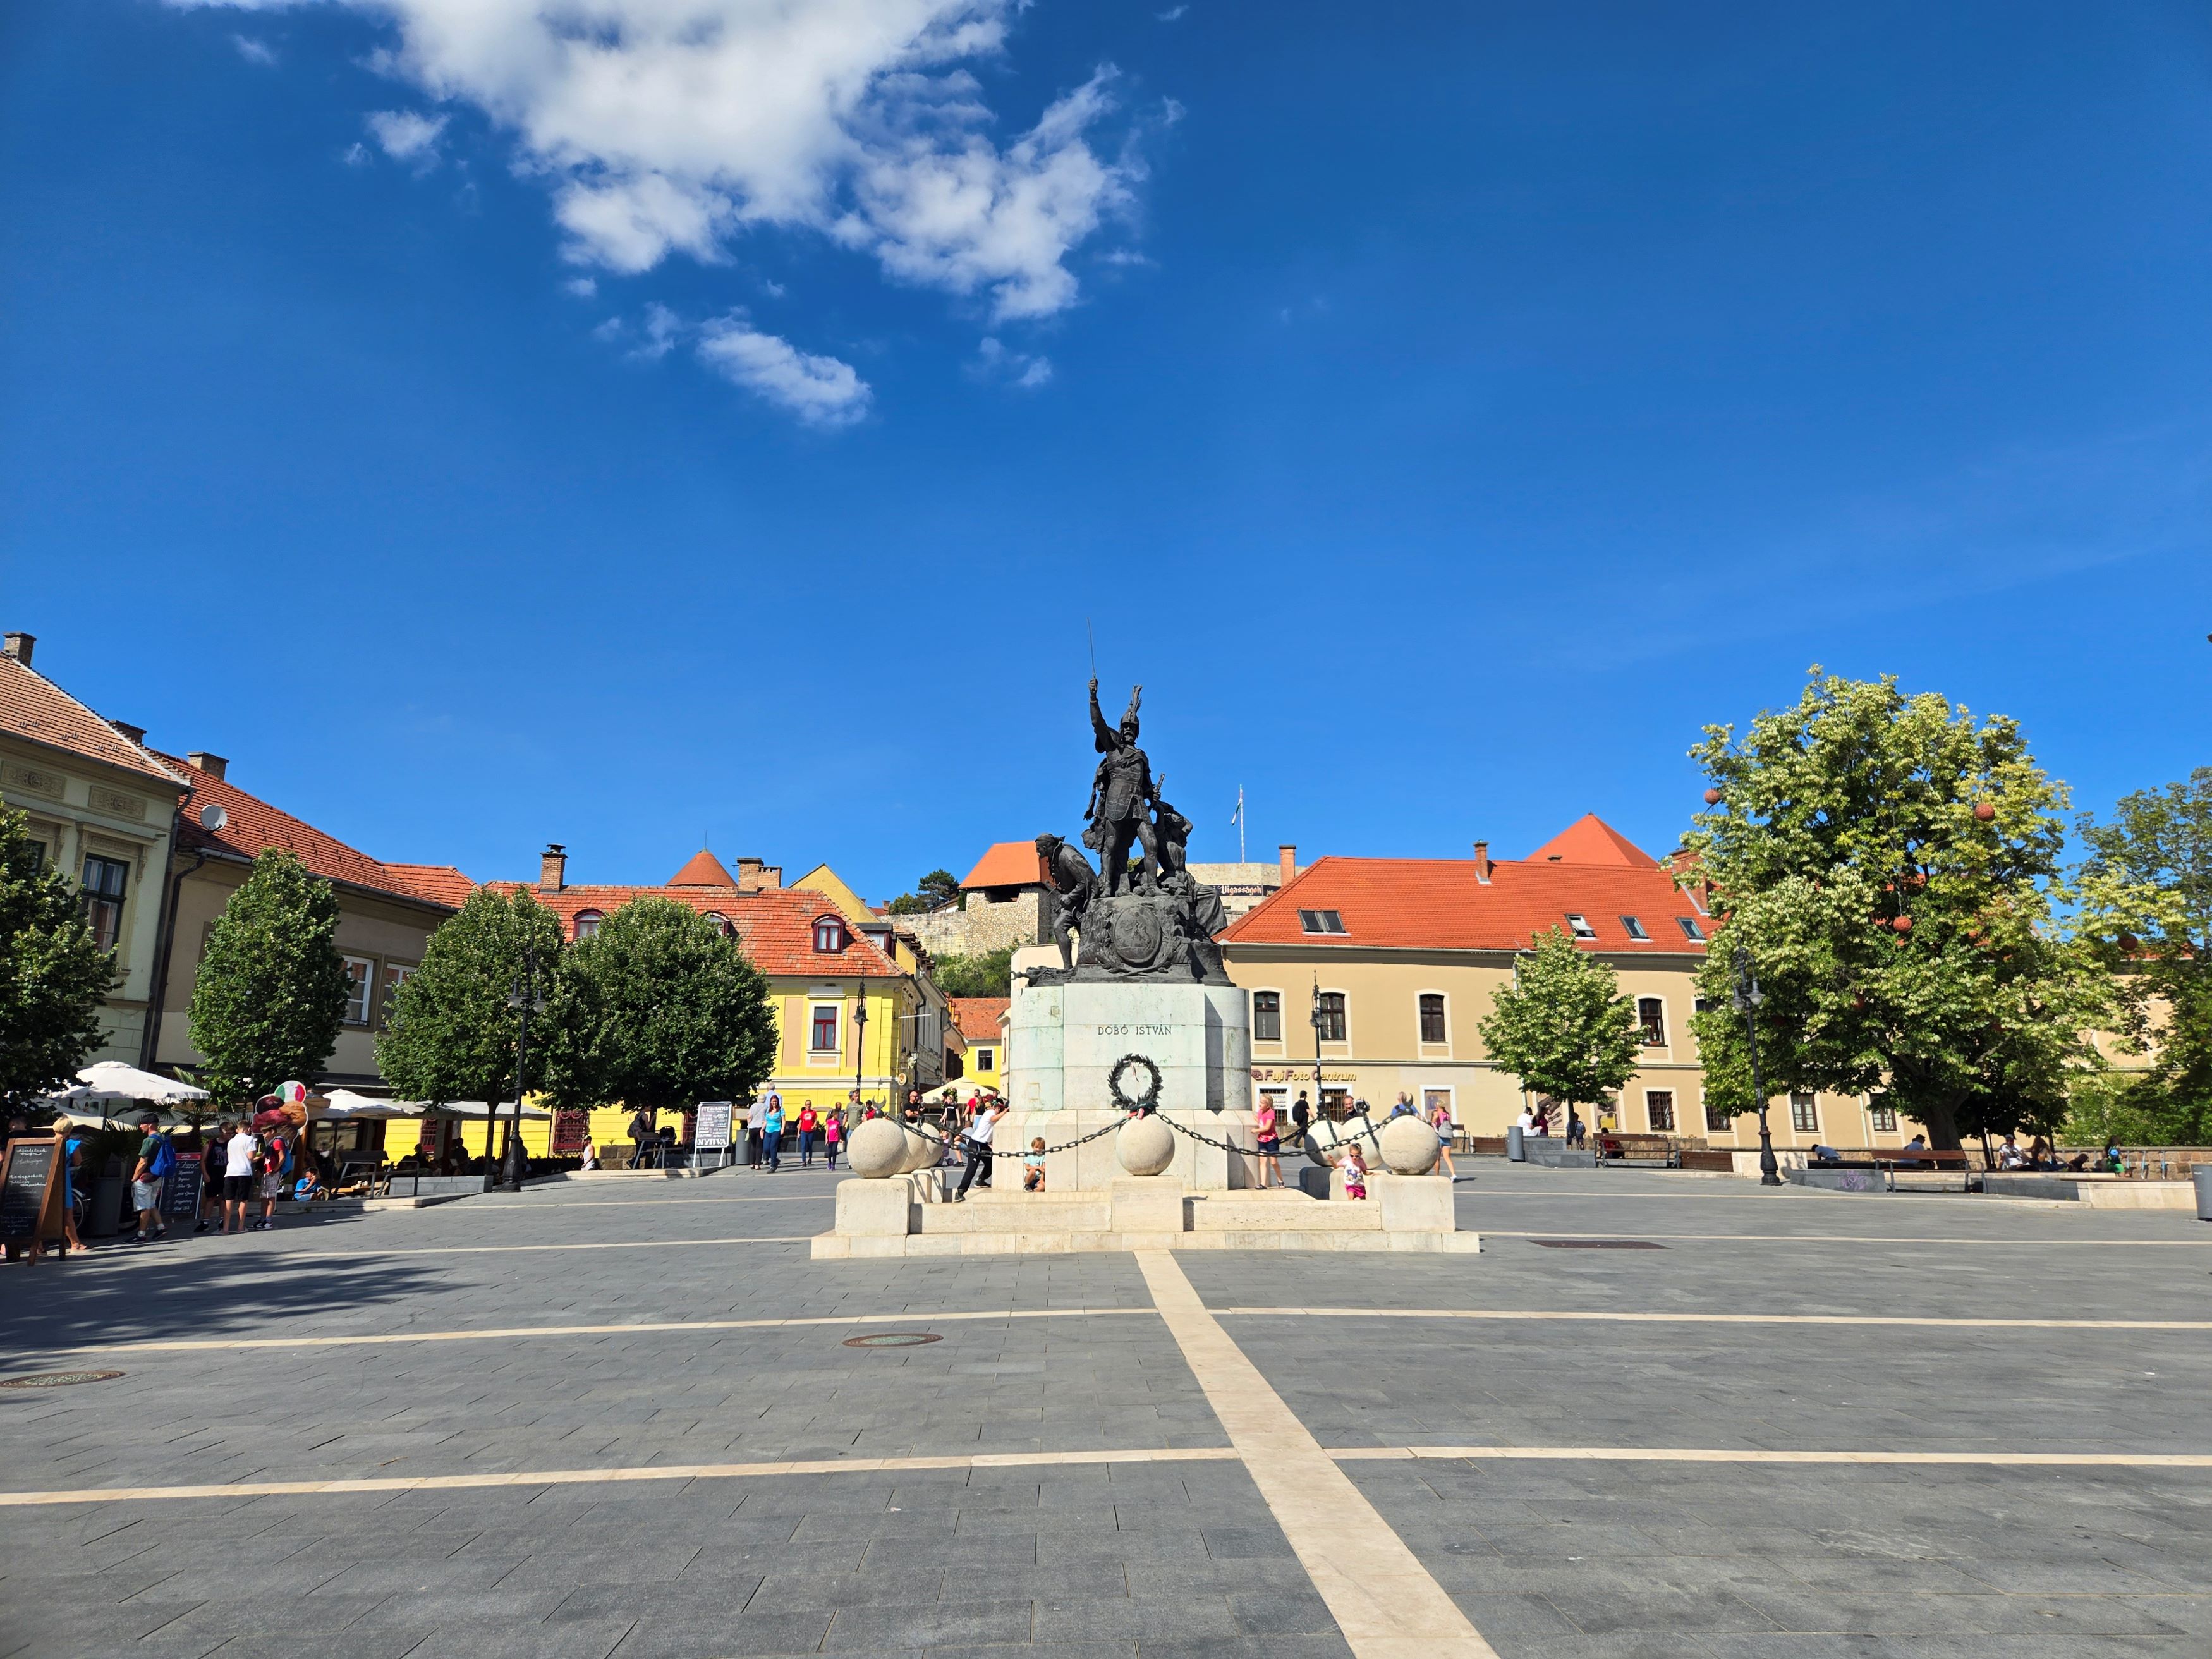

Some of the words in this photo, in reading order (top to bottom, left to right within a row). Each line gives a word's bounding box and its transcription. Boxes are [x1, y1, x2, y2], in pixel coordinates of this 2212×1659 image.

[1217, 885, 1261, 896] Vigasságok
[1098, 1024, 1129, 1035] DOBÓ
[1136, 1024, 1172, 1035] ISTVÁN
[1311, 1069, 1357, 1081] Centrum
